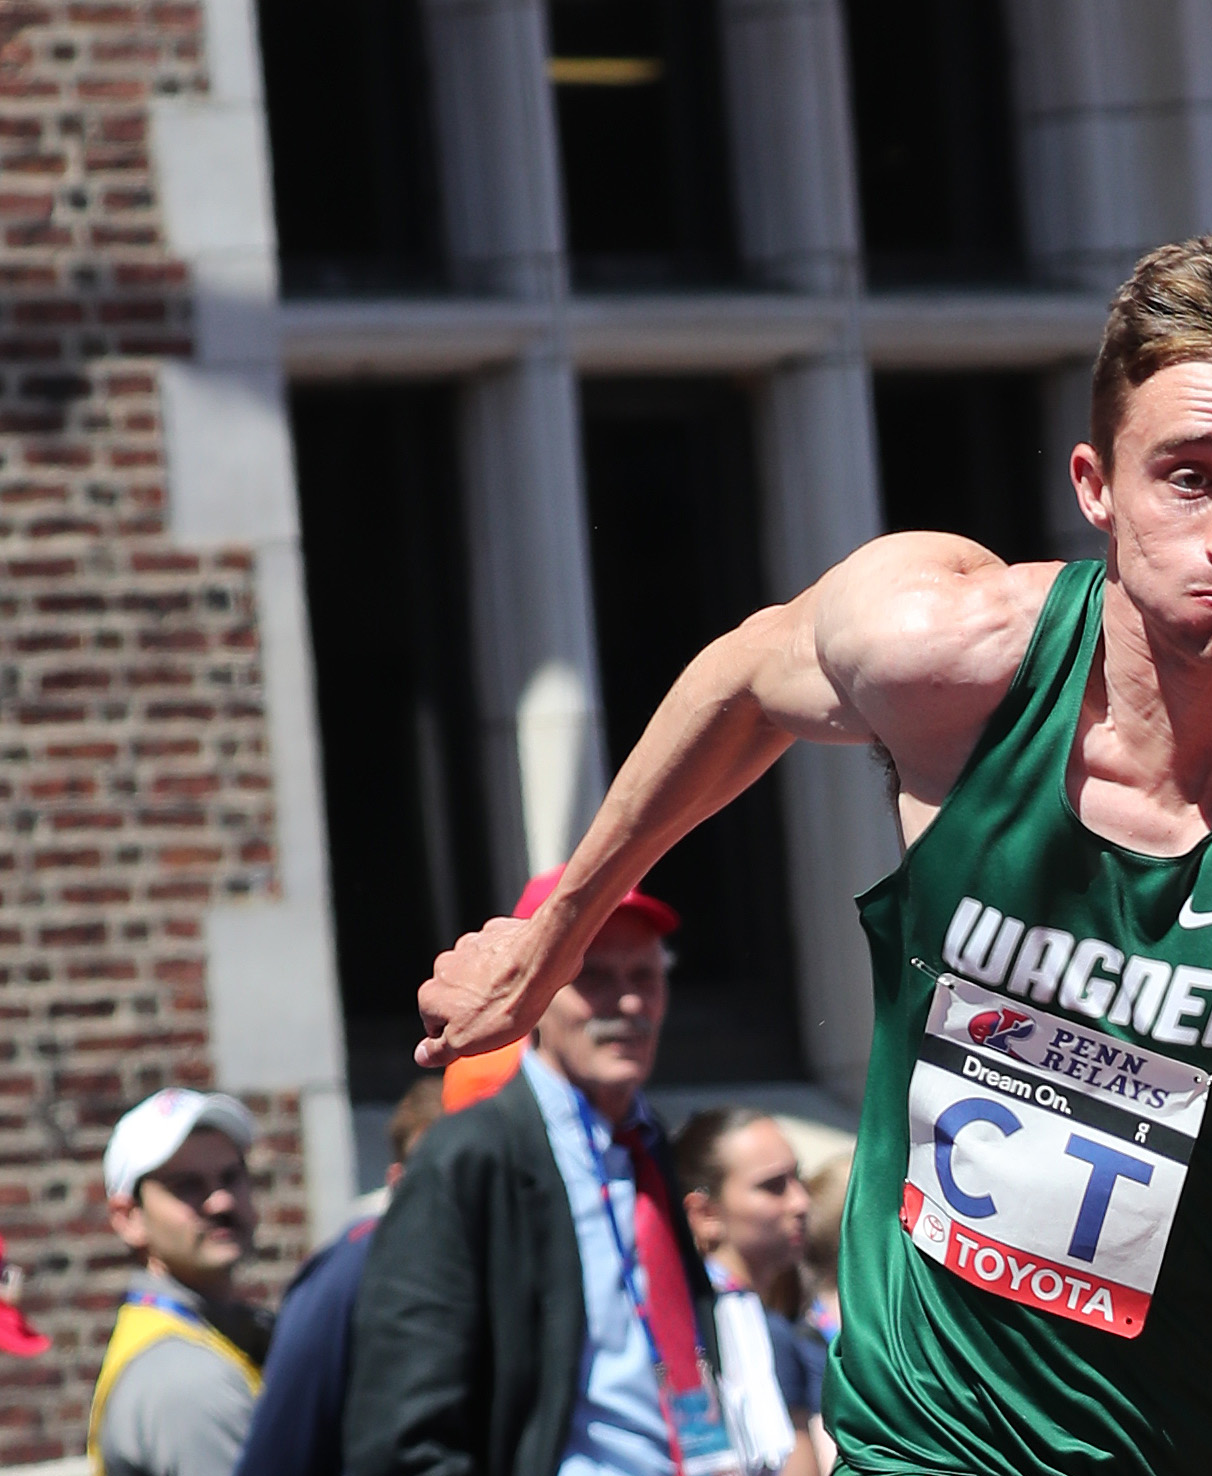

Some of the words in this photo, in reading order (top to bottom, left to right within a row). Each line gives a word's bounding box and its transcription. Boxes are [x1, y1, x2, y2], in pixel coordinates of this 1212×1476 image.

[1039, 1049, 1171, 1110] RELAYS
[1048, 1027, 1149, 1076] PENN
[961, 1054, 1032, 1102] Dream
[1034, 1085, 1073, 1115] On.
[933, 1096, 1023, 1219] C
[1064, 1133, 1156, 1263] T
[955, 1233, 1115, 1323] TOYOTA
